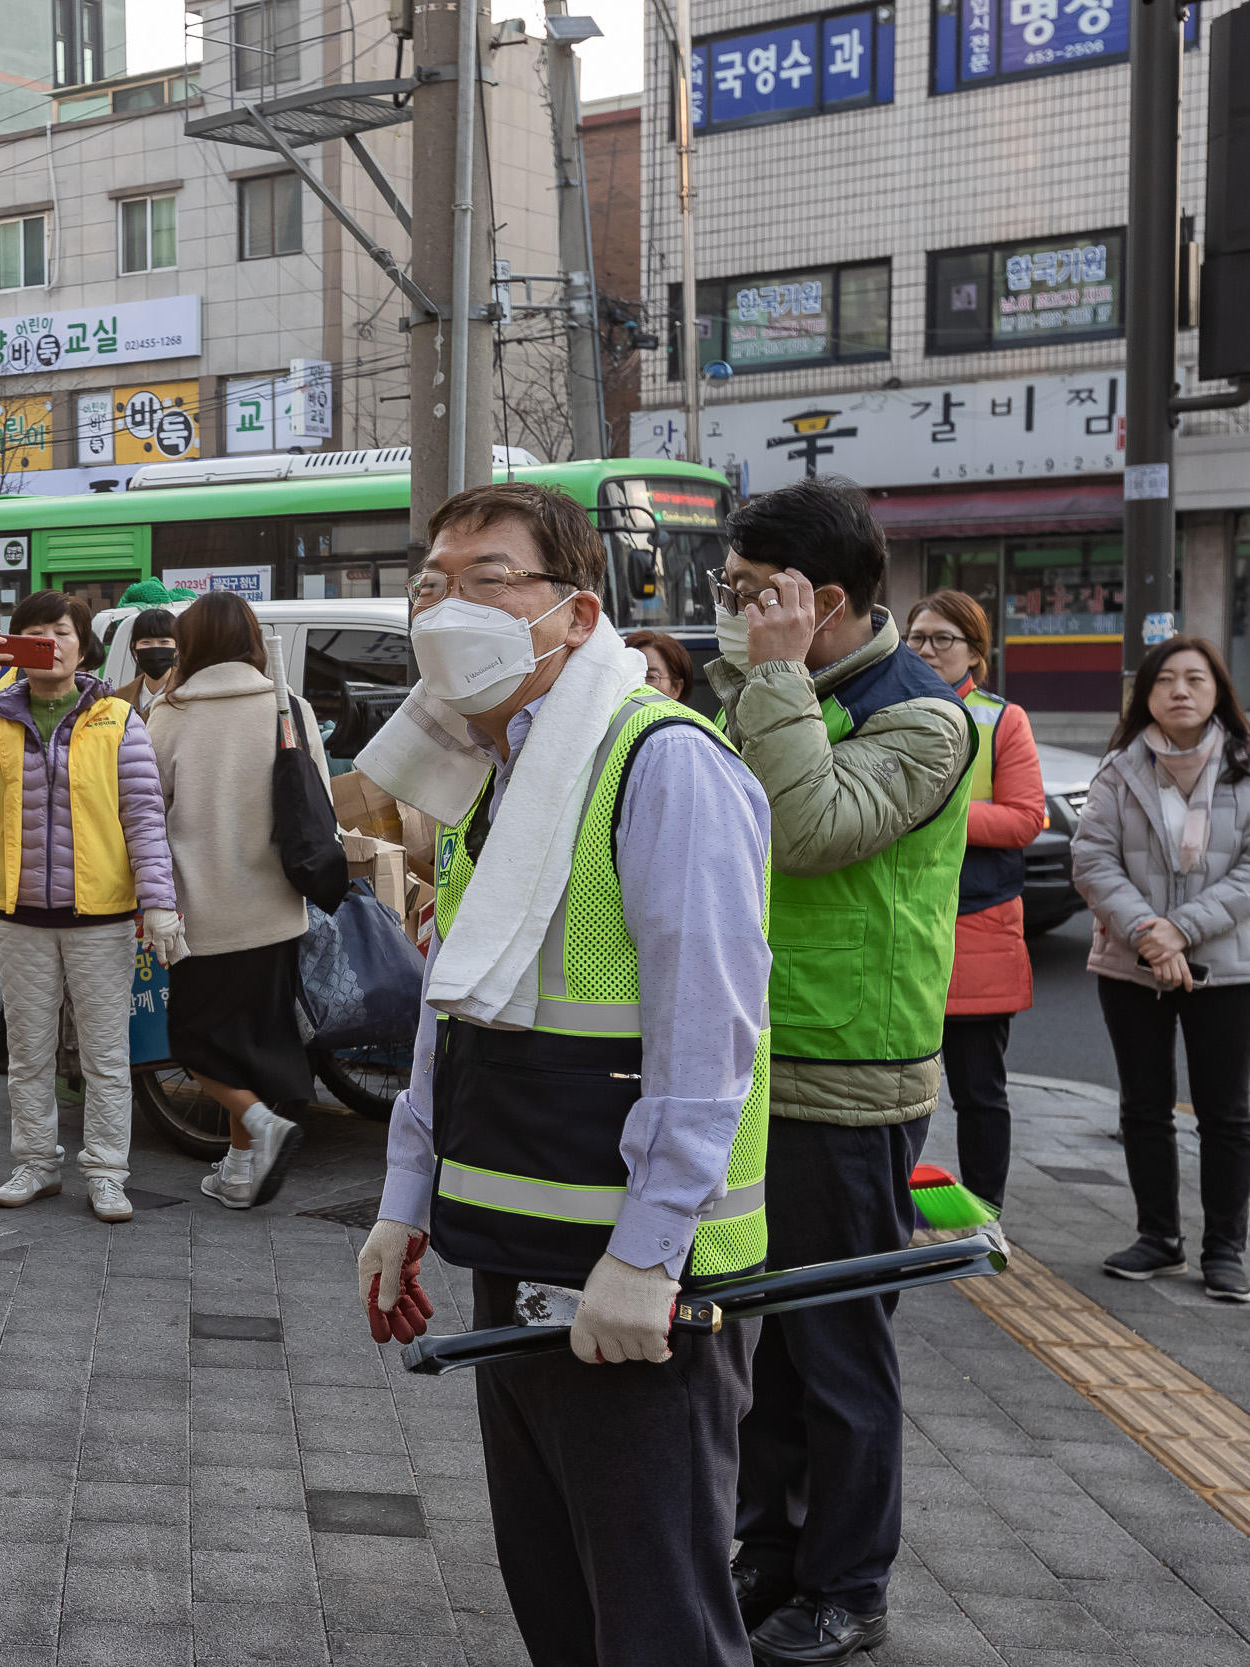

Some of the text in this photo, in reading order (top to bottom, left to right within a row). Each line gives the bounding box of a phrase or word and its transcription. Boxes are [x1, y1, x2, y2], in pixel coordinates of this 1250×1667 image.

[714, 39, 813, 99] 국영수
[1005, 244, 1107, 292] 한국기원
[736, 280, 823, 322] 한국기원
[9, 334, 62, 371] 바둑
[64, 316, 119, 355] 교실
[124, 334, 183, 352] 02)455-1268
[15, 316, 54, 336] 어린이
[130, 395, 193, 456] 바둑
[910, 377, 1117, 444] 갈비찜
[174, 579, 207, 590] 2023년
[212, 576, 258, 589] 광진구 청년
